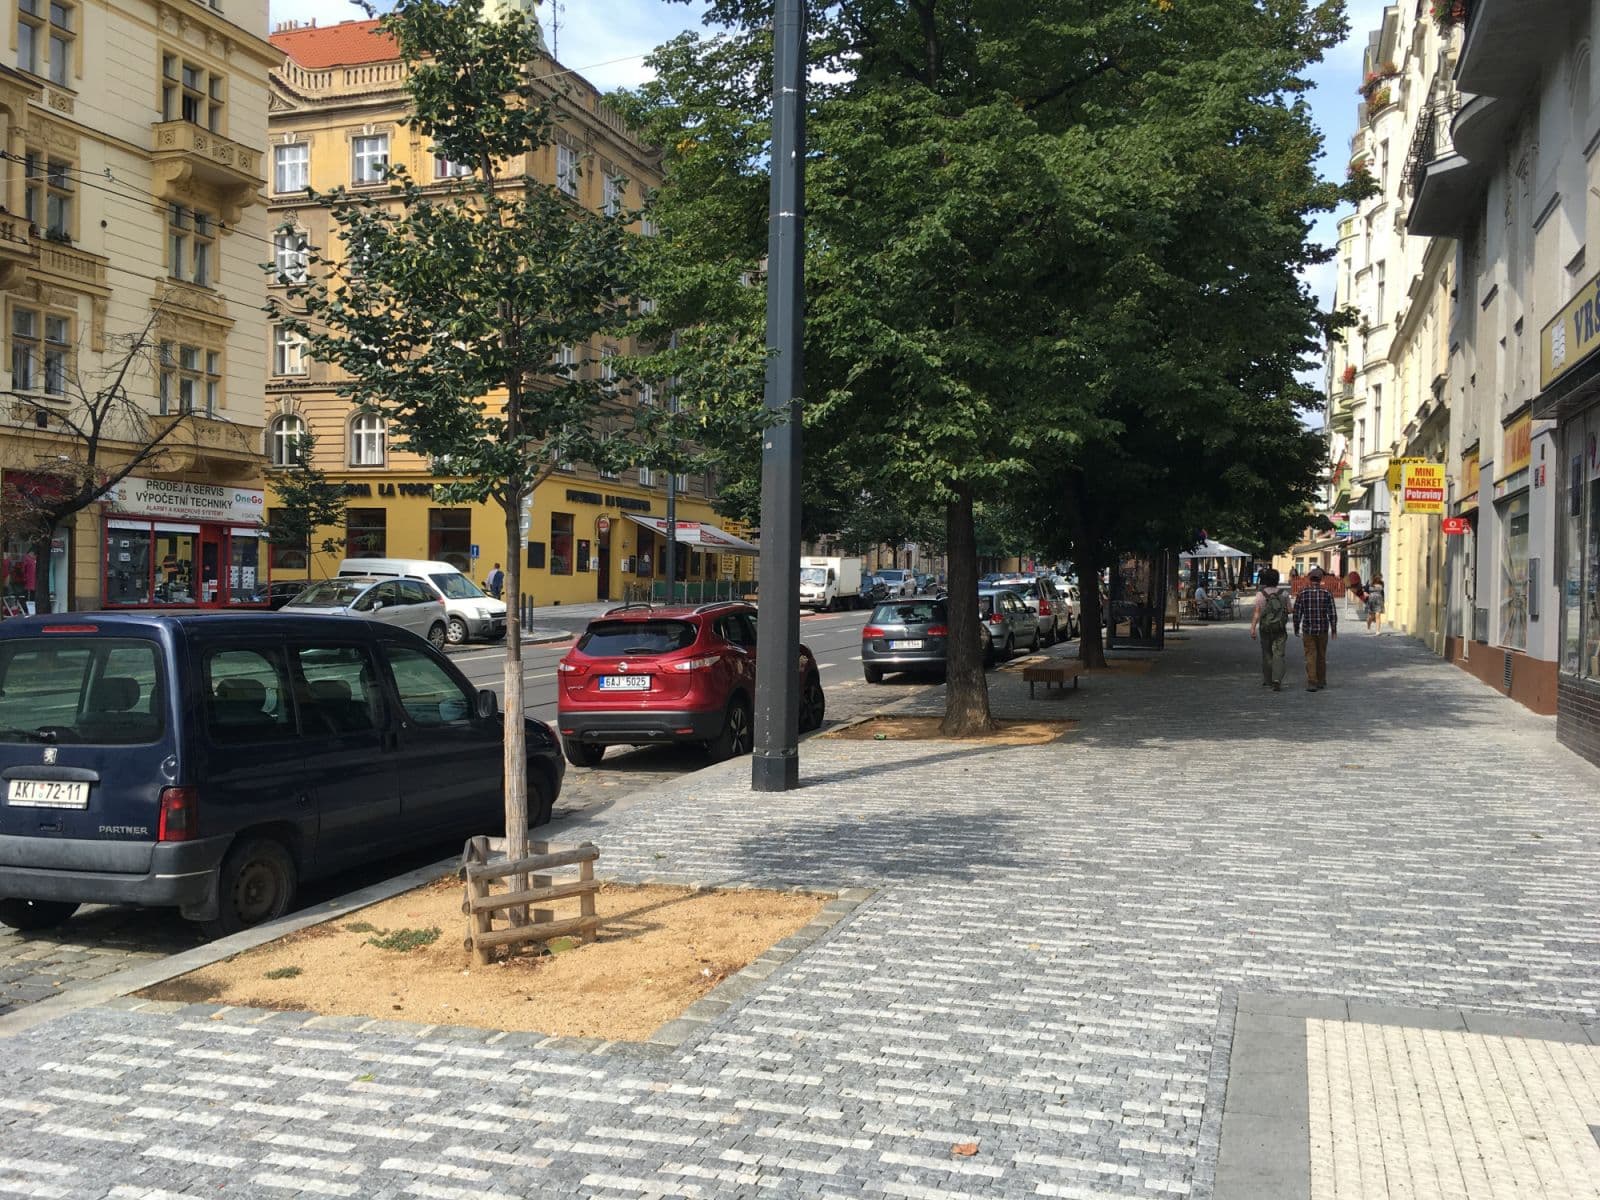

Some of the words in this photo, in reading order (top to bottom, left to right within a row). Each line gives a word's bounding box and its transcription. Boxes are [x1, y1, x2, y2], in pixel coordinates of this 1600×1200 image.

[1415, 467, 1434, 477] MINI
[1407, 477, 1441, 487] MARKET
[146, 480, 183, 493] PRODEJ
[185, 483, 192, 494] A
[193, 485, 224, 497] SERVIS
[136, 490, 189, 505] VÝPOČETNÍ
[191, 496, 233, 509] TECHNIKY
[235, 493, 263, 505] OneGo
[1406, 489, 1442, 501] Potraviny
[606, 678, 621, 687] 6AJ
[626, 677, 646, 686] 5025
[46, 783, 81, 800] 72-11
[98, 825, 149, 835] PARTNER
